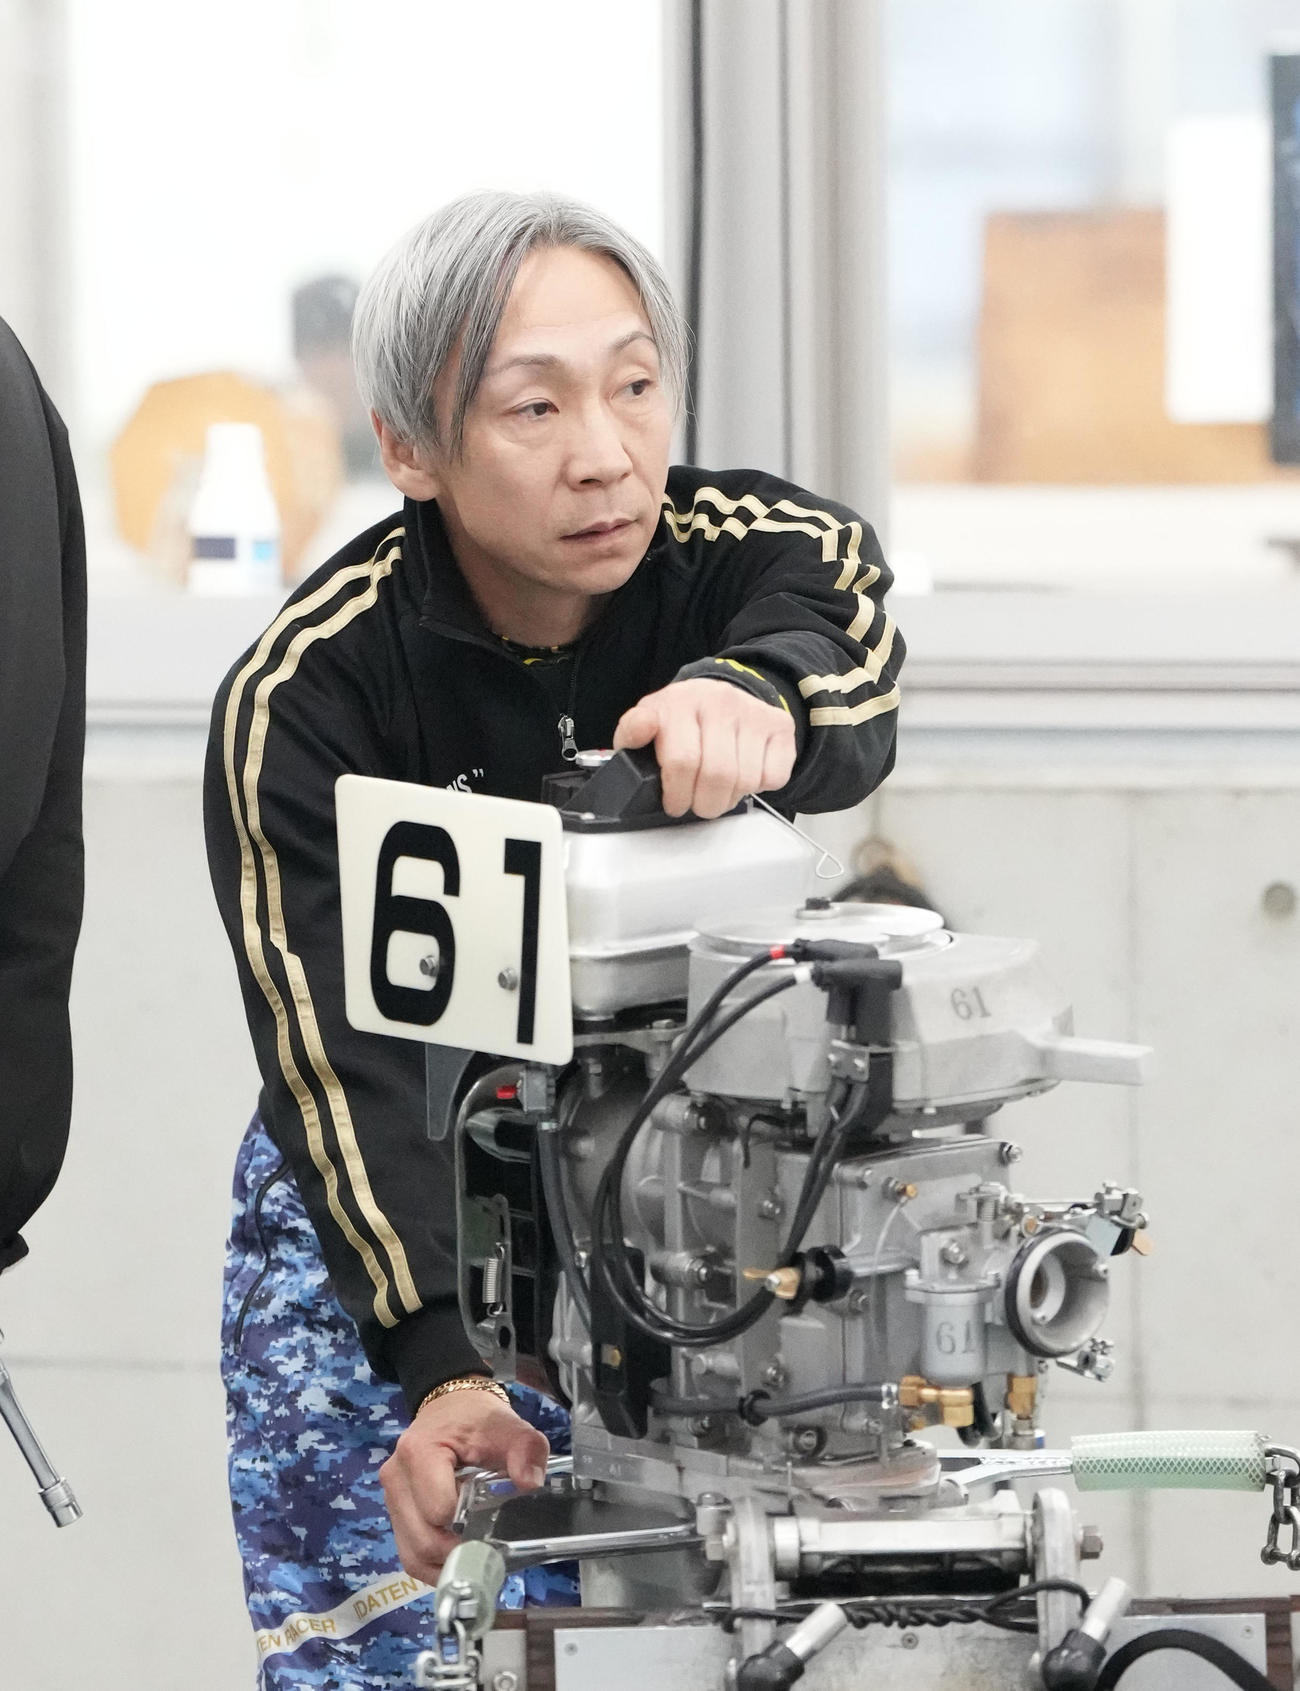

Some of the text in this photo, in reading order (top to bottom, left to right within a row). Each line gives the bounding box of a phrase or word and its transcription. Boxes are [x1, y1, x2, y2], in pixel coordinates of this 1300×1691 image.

[371, 821, 542, 1045] 61
[950, 986, 992, 1020] 61
[936, 1320, 975, 1354] 61
[284, 1618, 336, 1645] RACER
[352, 1577, 418, 1620] IDATEN
